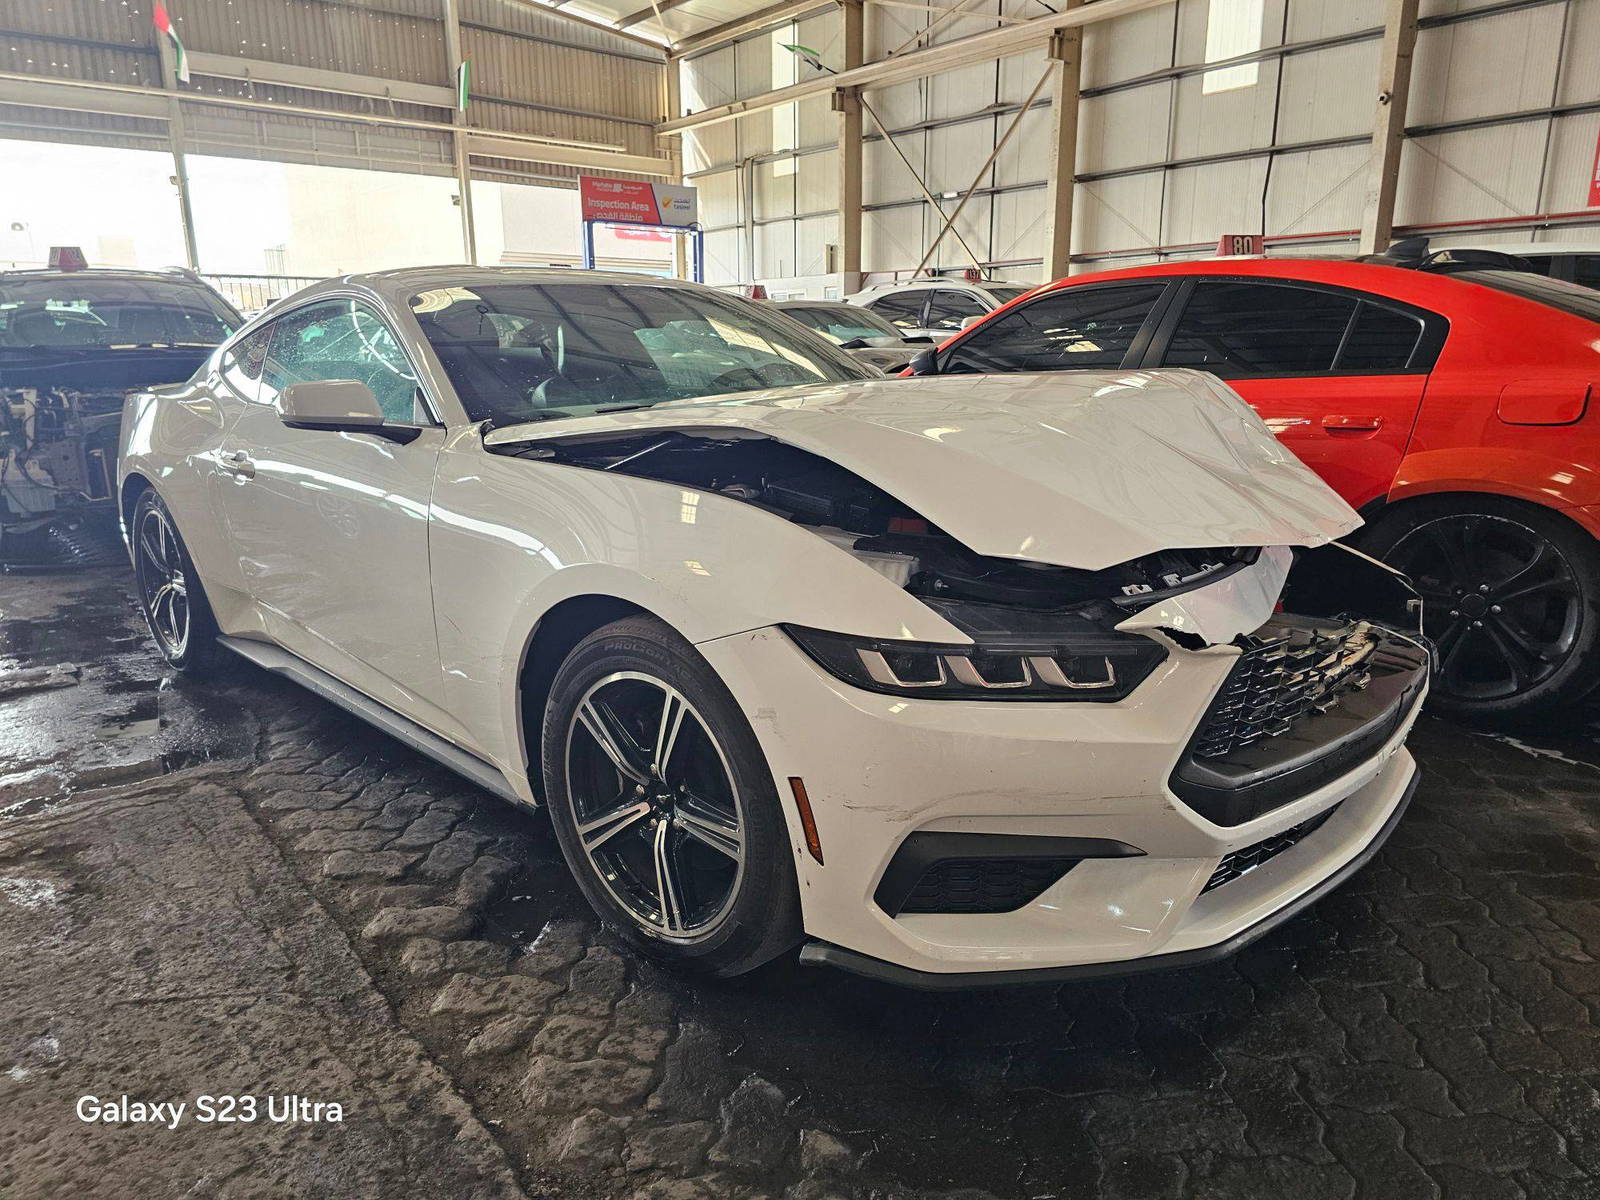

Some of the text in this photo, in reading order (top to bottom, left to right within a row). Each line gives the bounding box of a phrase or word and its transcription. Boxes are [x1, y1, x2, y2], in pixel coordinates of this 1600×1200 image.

[588, 197, 649, 212] Inspection Area
[1233, 236, 1253, 255] 80
